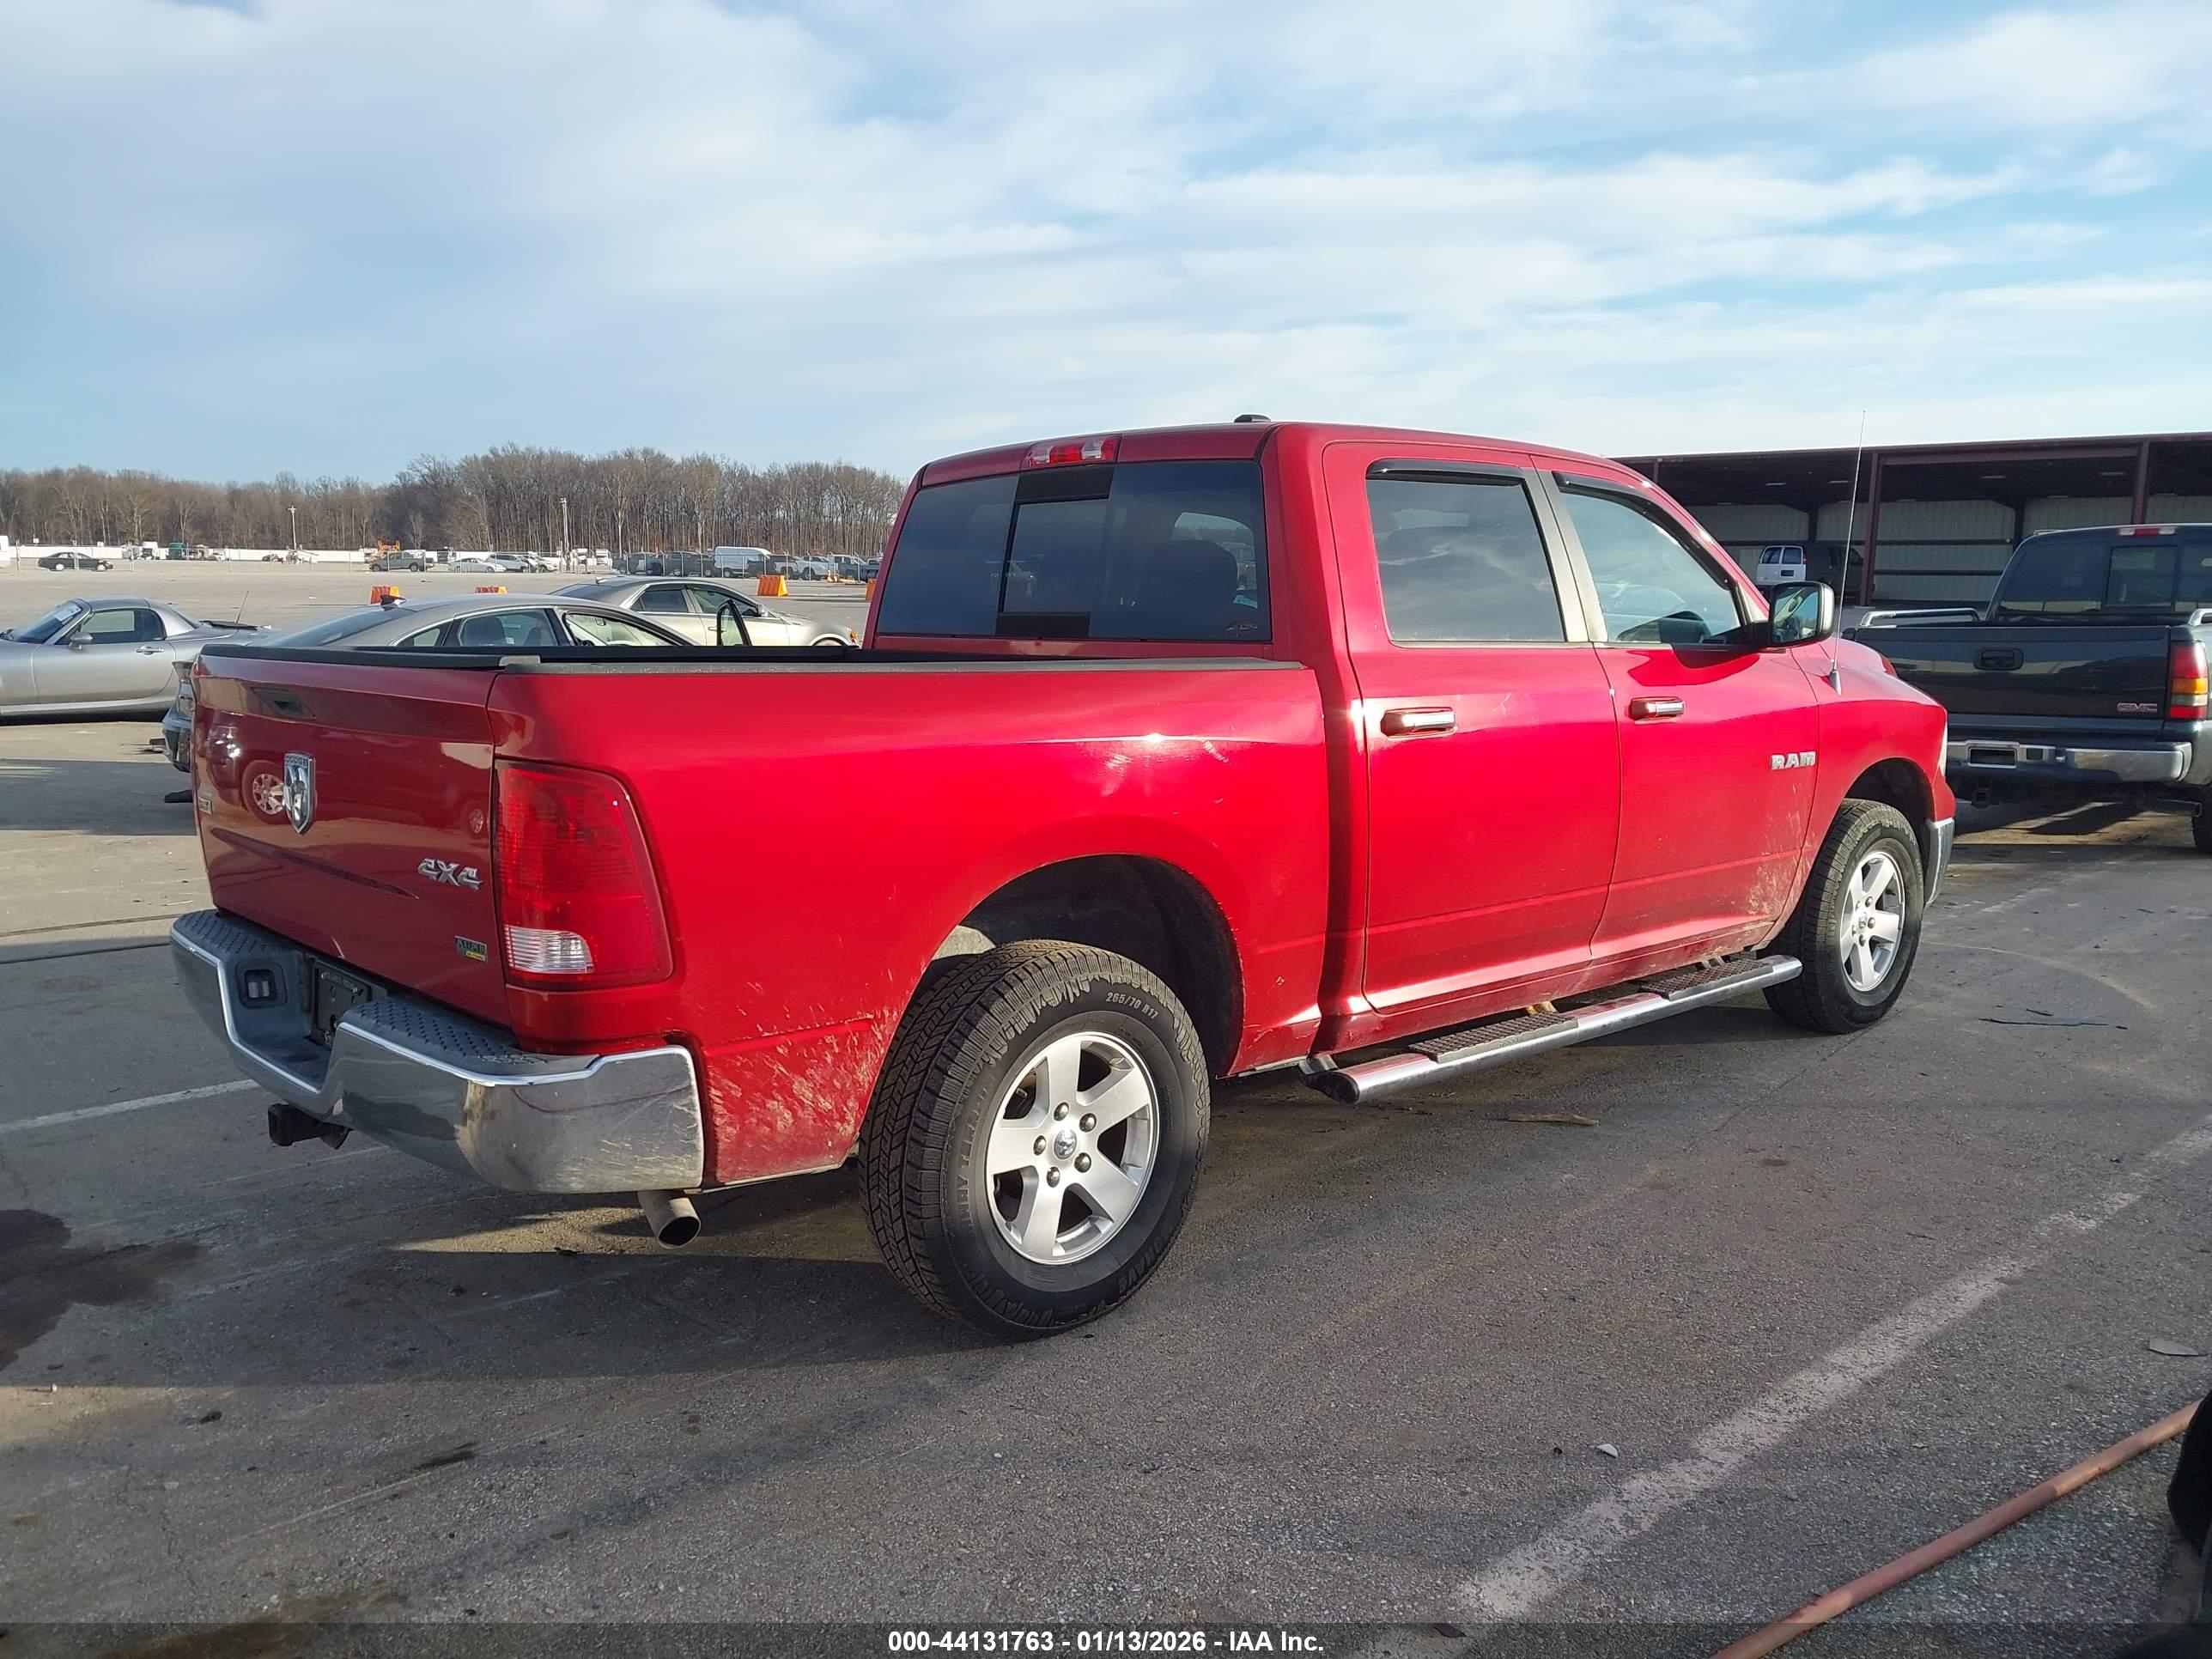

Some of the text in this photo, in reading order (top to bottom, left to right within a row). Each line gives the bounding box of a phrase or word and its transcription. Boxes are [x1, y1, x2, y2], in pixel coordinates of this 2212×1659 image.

[2117, 702, 2158, 713] GMC
[1771, 751, 1816, 770] RAM
[1105, 992, 1159, 1019] 265/70 R17
